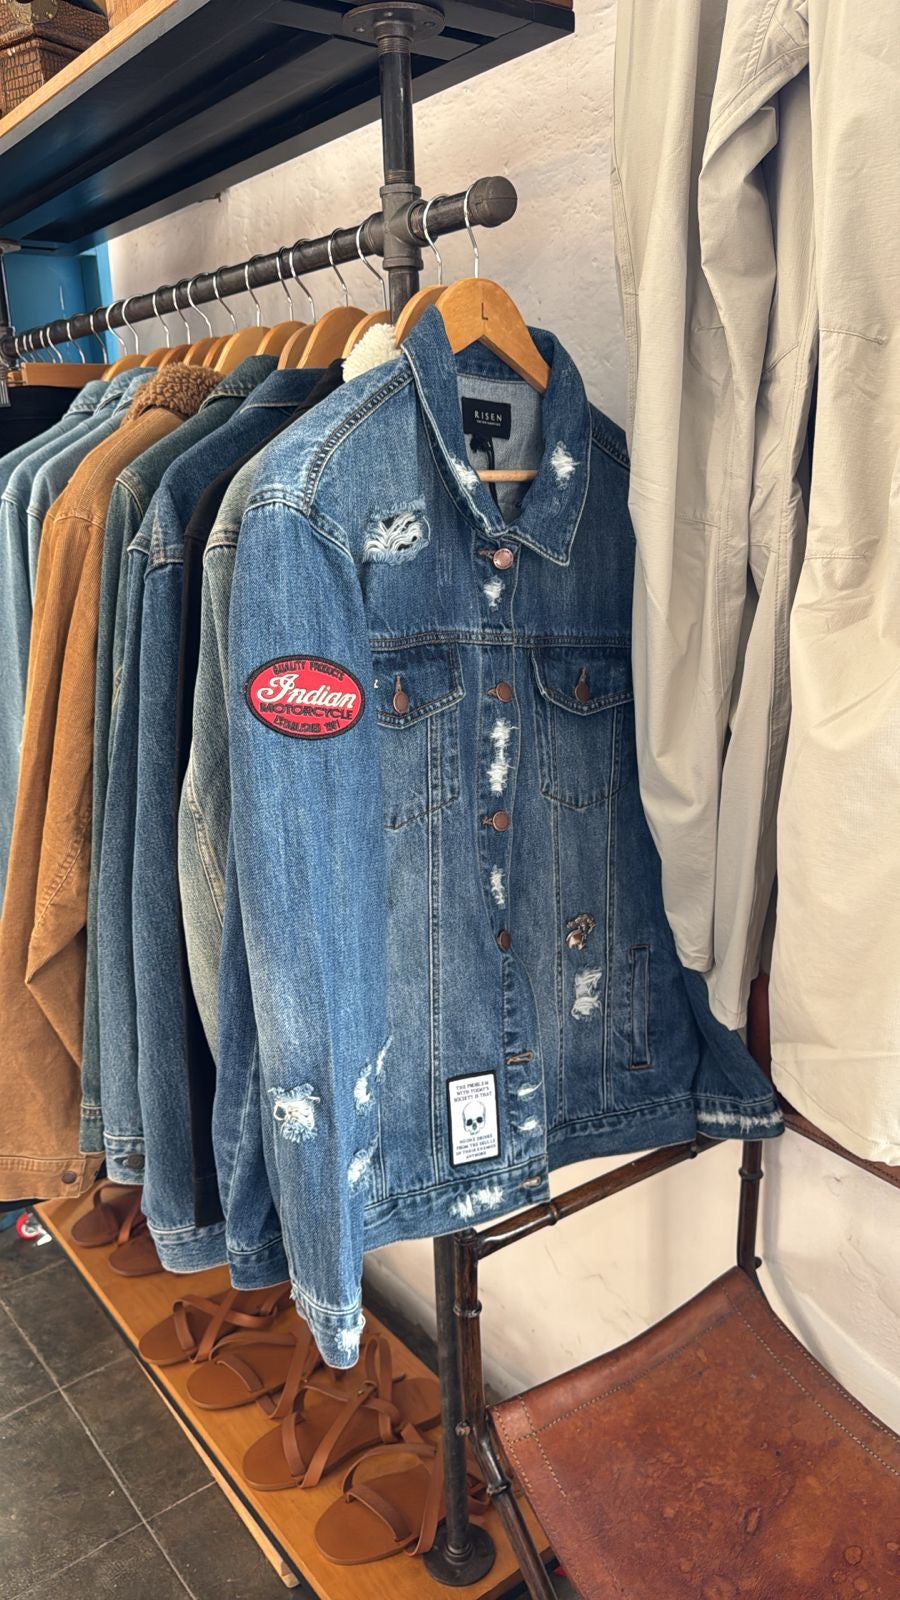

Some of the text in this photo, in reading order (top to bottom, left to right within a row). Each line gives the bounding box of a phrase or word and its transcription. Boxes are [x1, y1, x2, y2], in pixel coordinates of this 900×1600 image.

[481, 302, 489, 320] L
[474, 410, 503, 422] RISEN
[256, 673, 357, 708] Indian
[259, 702, 354, 720] MOTORCYCLE
